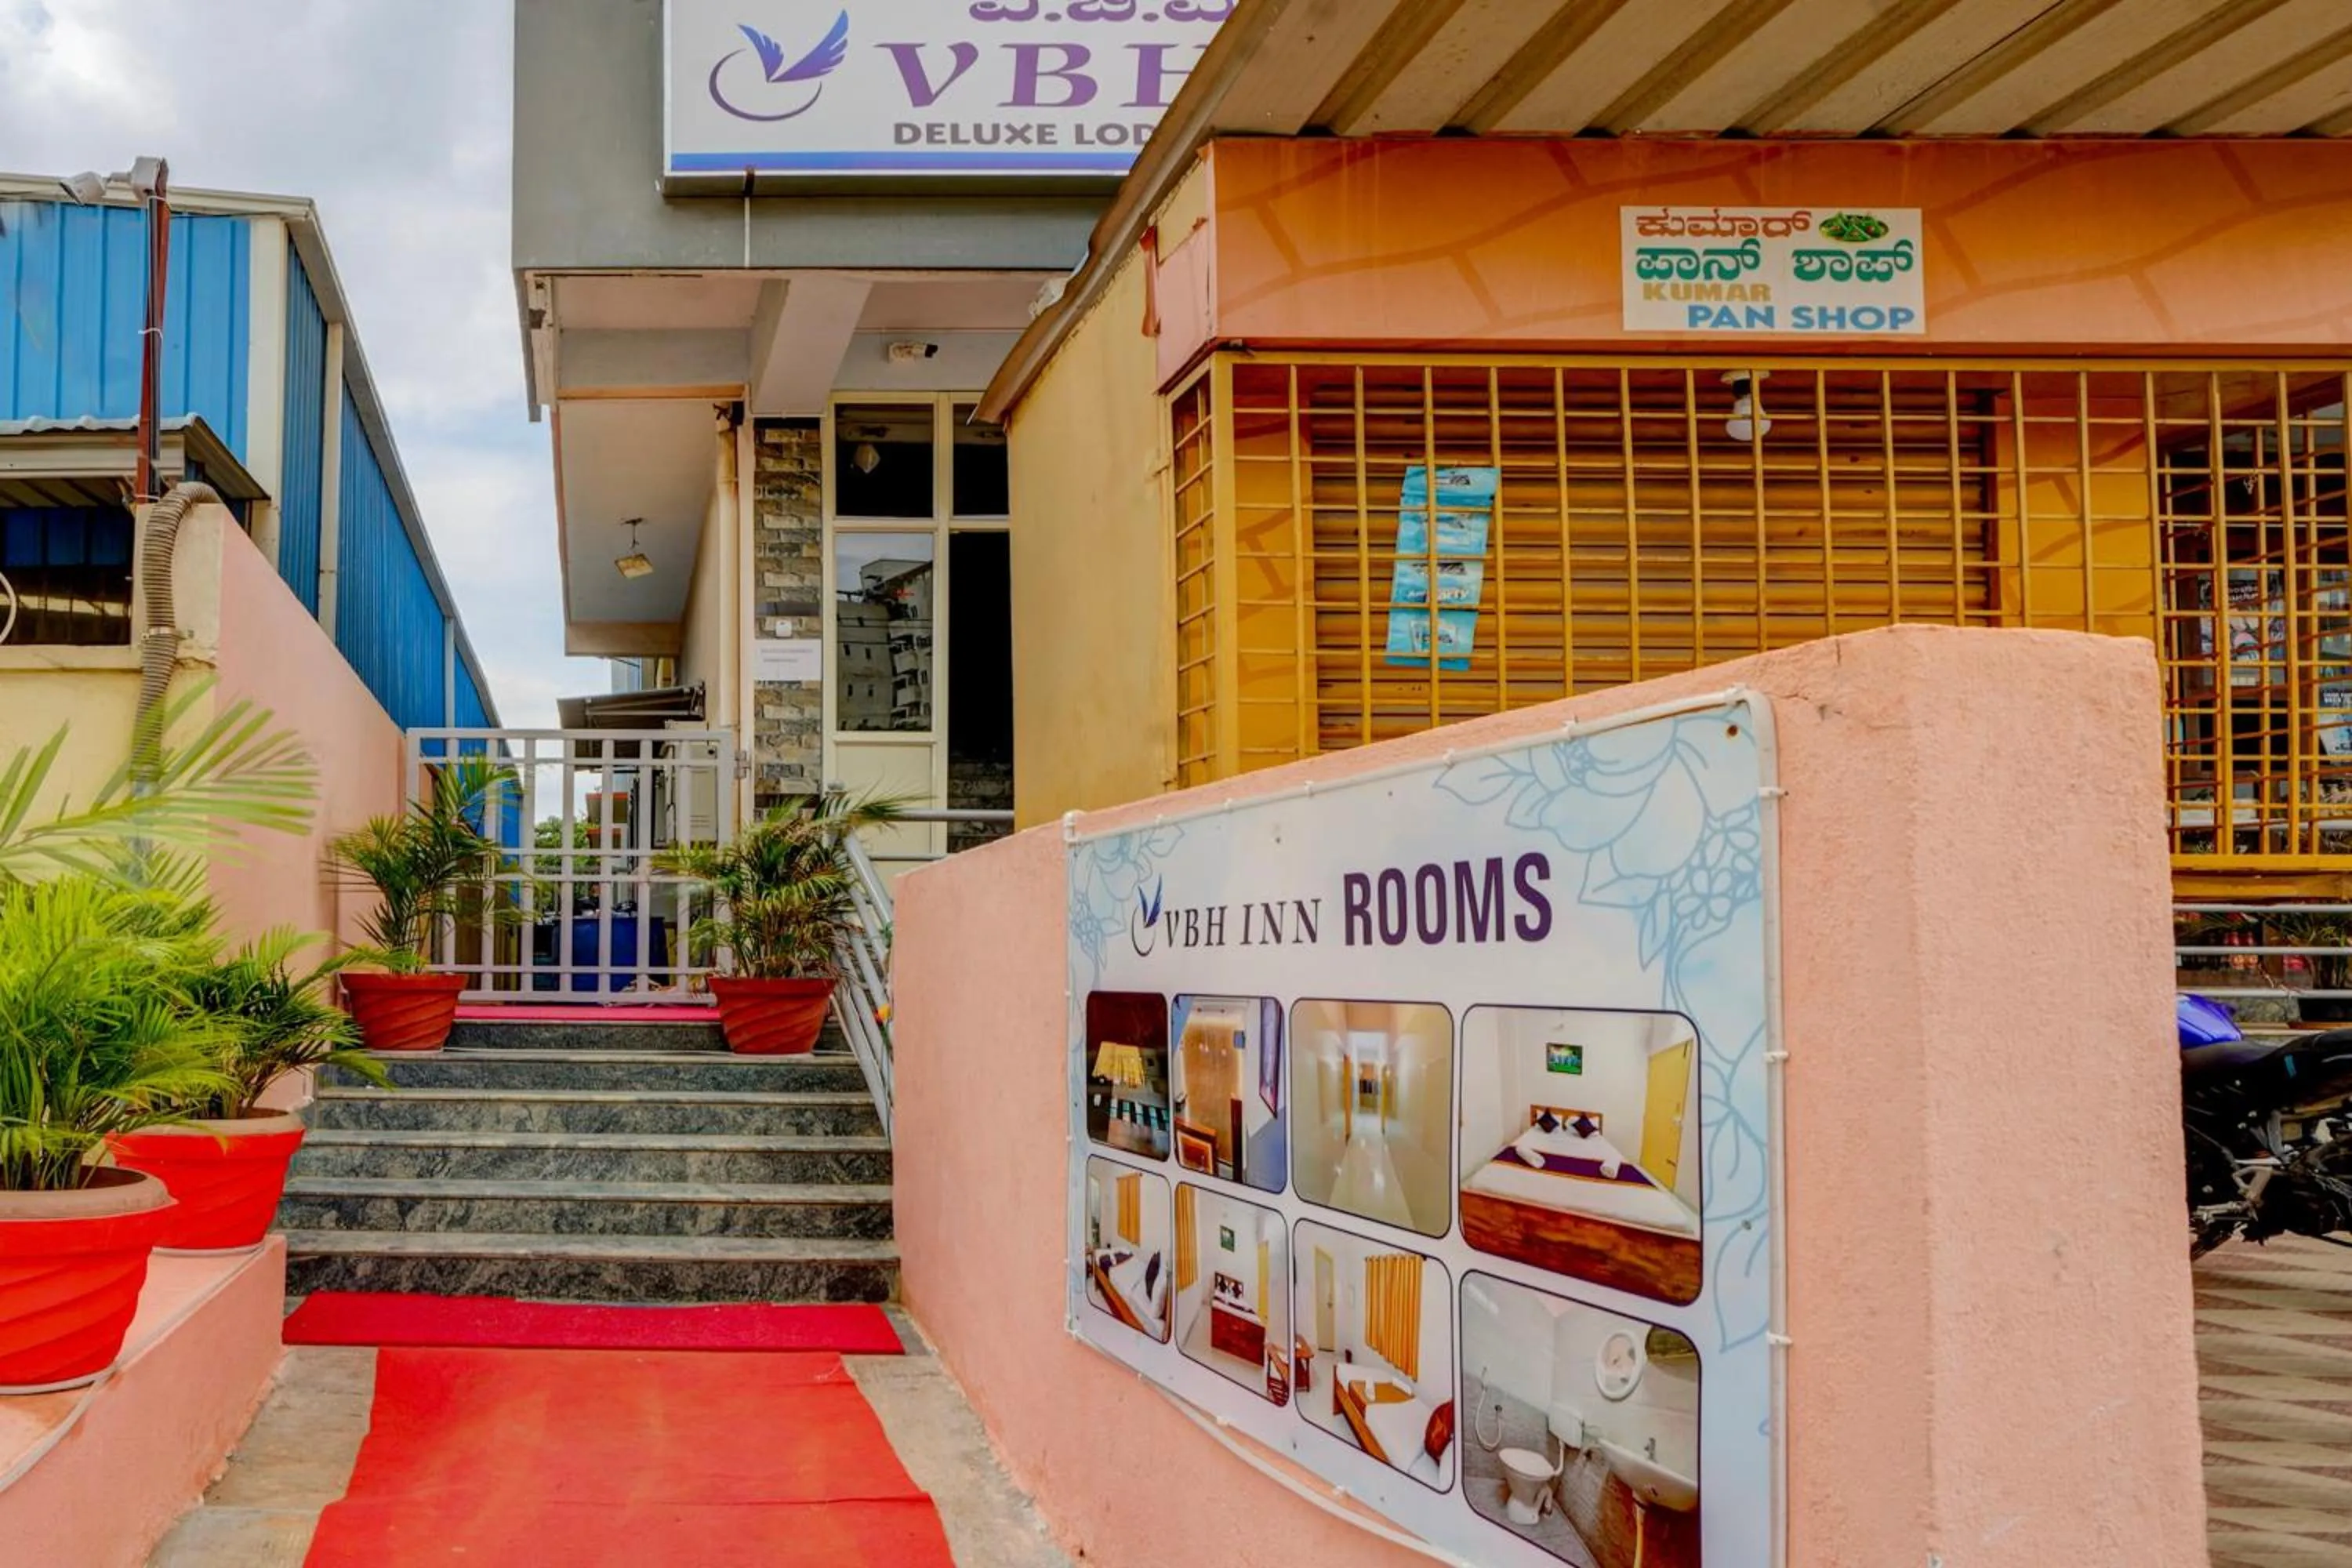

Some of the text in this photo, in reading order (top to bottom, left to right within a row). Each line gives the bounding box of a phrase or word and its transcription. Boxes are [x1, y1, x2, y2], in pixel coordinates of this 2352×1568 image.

[894, 122, 1058, 145] DELUXE
[1636, 208, 1812, 238] ಕುಮಾರ್
[1635, 238, 1761, 281] ಪಾನ್
[1643, 282, 1772, 303] KUMAR
[1688, 304, 1915, 331] PAN SHOP
[1164, 851, 1553, 948] VBH INN ROOMS
